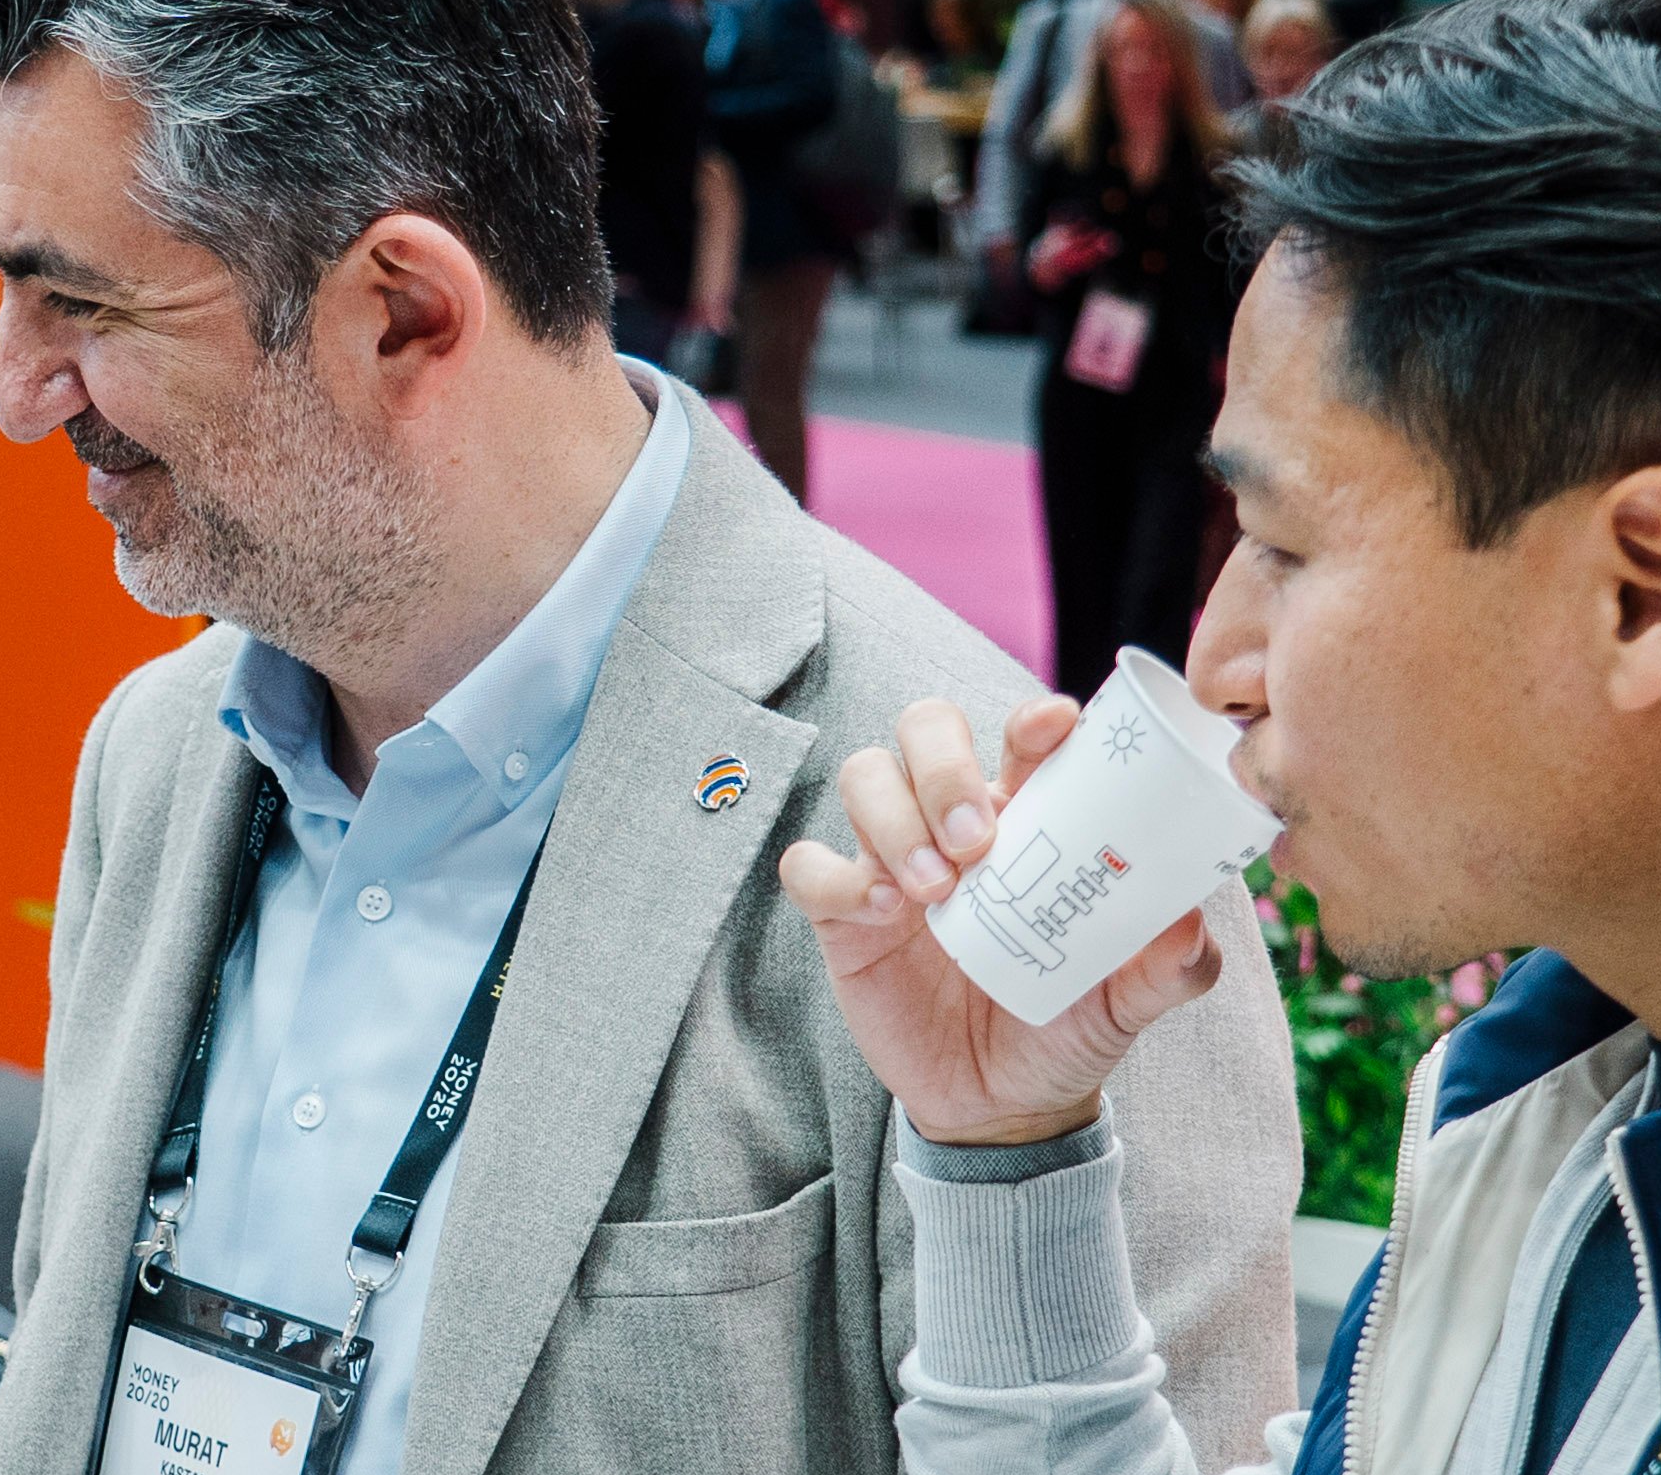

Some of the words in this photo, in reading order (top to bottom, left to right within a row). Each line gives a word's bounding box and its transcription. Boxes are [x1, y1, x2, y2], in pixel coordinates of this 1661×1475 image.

[426, 1053, 465, 1120] 20/20
[436, 1058, 478, 1132] MONEY
[126, 1382, 170, 1412] 20/20
[130, 1362, 180, 1394] MONEY
[154, 1418, 228, 1468] MURAT
